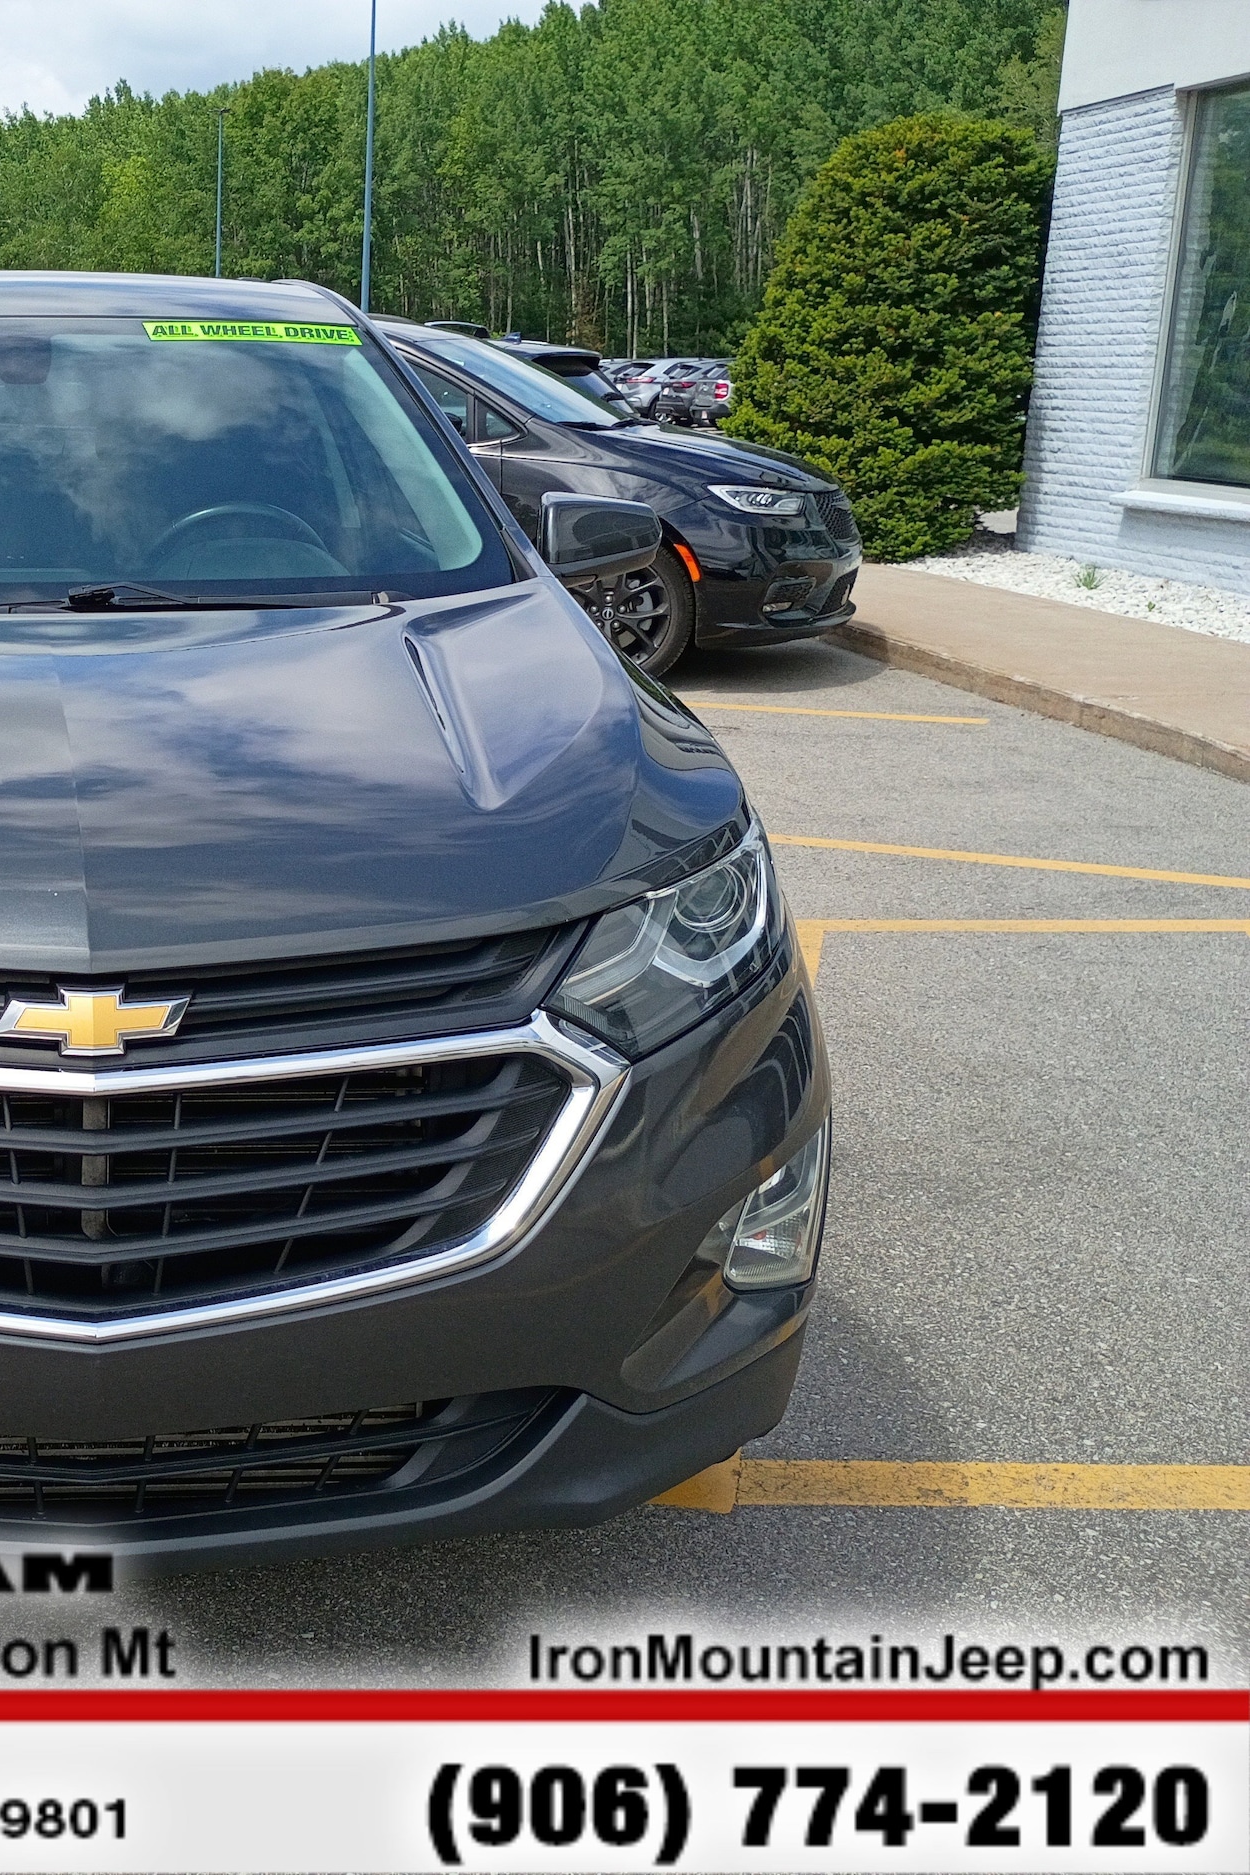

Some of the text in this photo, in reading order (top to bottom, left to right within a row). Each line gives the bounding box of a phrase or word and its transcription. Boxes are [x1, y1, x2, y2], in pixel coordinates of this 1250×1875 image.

[151, 324, 351, 340] ALL WHEEL DRIVE
